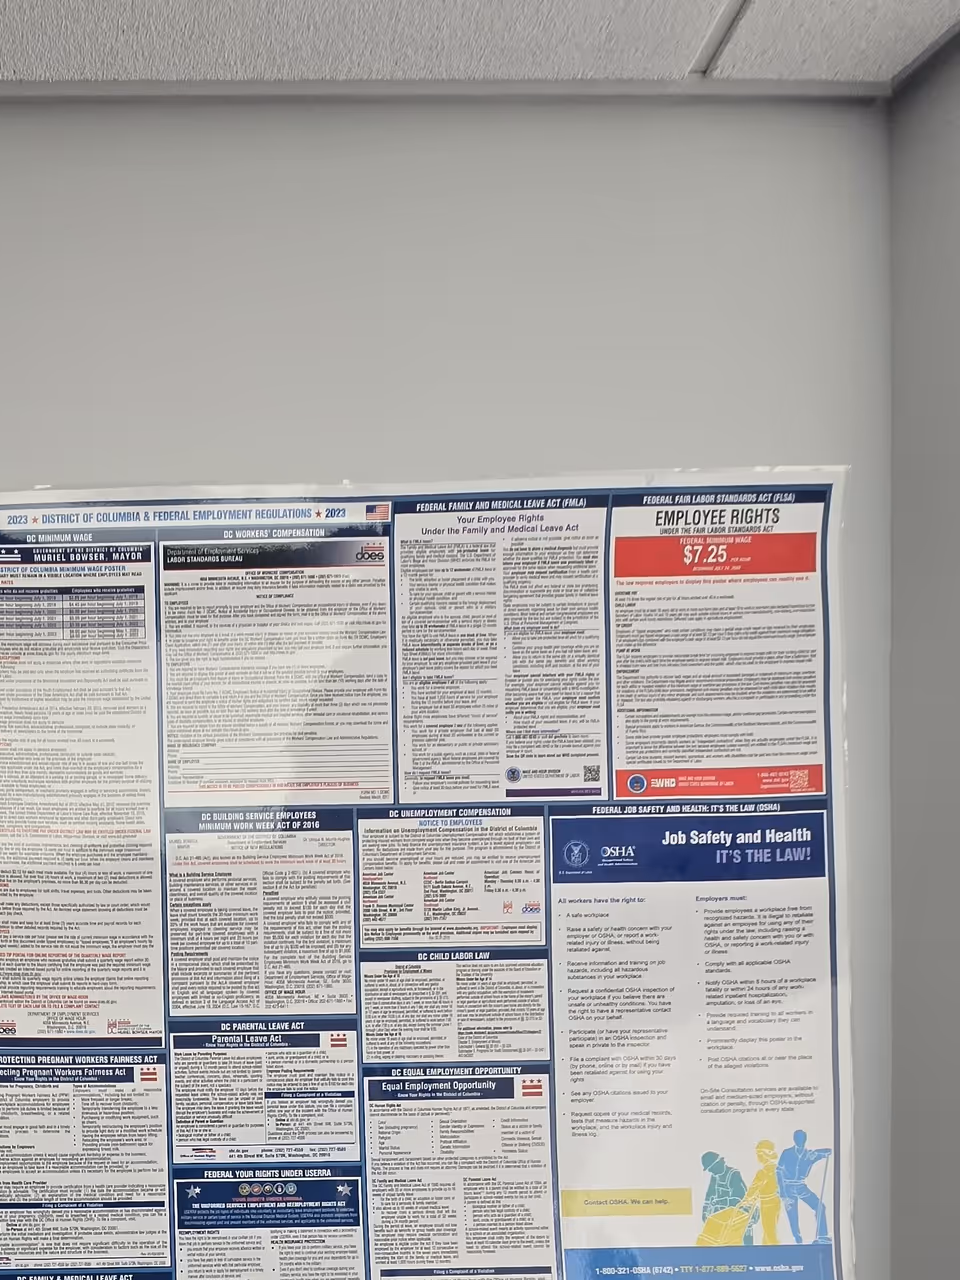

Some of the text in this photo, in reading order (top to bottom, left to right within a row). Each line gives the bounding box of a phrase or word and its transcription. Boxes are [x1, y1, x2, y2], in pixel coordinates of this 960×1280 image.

[642, 493, 795, 504] FEDERAL FAIR LABOR STANDARDS ACT (FLSA)
[416, 498, 586, 511] FEDERAL FAMILY AND MEDICAL LEAVE ACT (FMLA)
[7, 507, 346, 524] 2023 DISTRICT OF COLUMBIA & FEDERAL EMPLOYMENT REGULATIONS 2023
[477, 515, 516, 524] Employee
[518, 514, 544, 523] Rights
[655, 508, 779, 526] EMPLOYEE RIGHTS
[223, 528, 324, 538] DC WORKERS' COMPENSATION
[462, 526, 488, 534] Family
[38, 534, 71, 542] MINIMUM
[72, 533, 92, 541] WAGE
[683, 544, 726, 563] $7.25
[276, 811, 316, 819] EMPLOYEES
[400, 809, 456, 817] UNEMPLOYMENT
[458, 808, 511, 816] COMPENSATION
[662, 828, 811, 846] Job Safety and Health
[745, 848, 771, 862] THE
[776, 847, 810, 861] LAW!
[232, 1022, 266, 1030] PARENTAL
[22, 1068, 52, 1078] Pregnant
[381, 1081, 496, 1091] Equal Employment Opportunity
